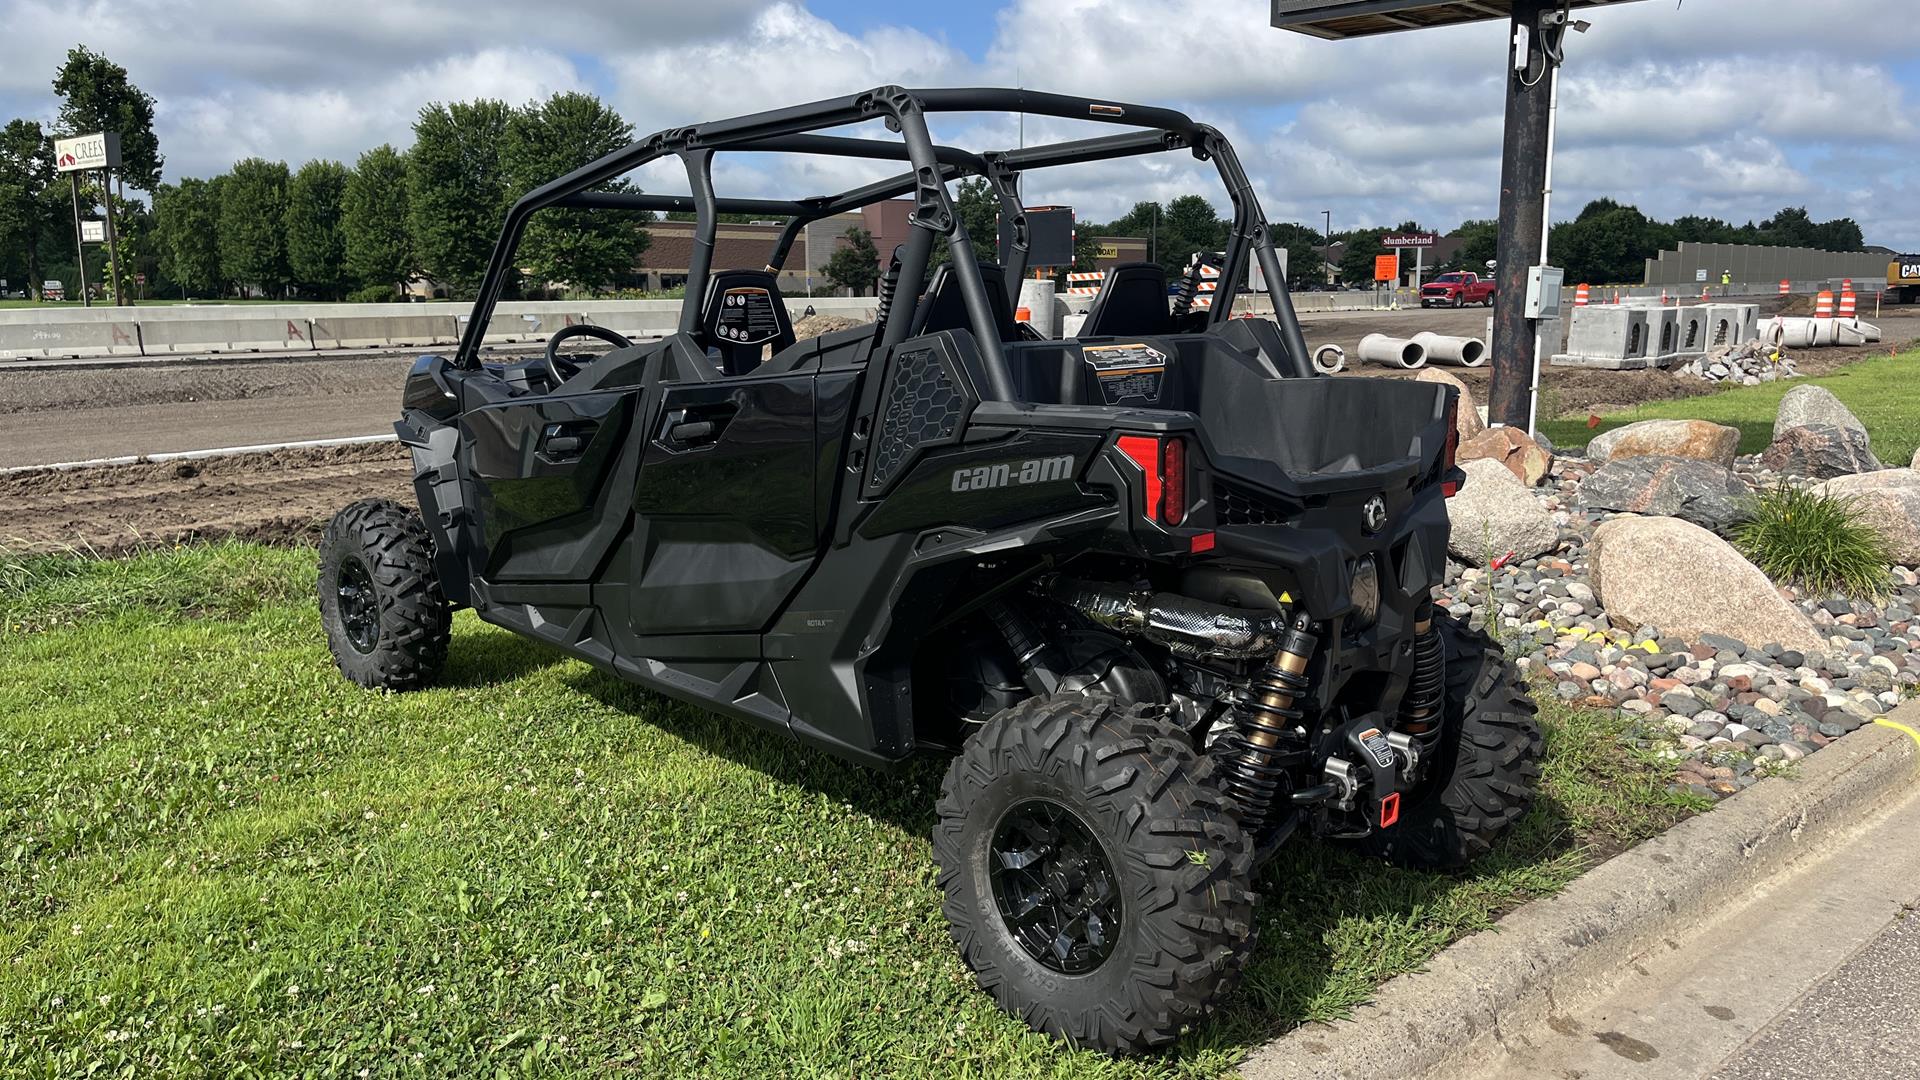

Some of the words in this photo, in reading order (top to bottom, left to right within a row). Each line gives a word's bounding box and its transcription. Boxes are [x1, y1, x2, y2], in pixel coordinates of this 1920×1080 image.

[74, 140, 104, 160] CREES
[1383, 236, 1433, 245] slumberland
[1097, 248, 1116, 256] ODAY!
[951, 455, 1075, 492] can-am
